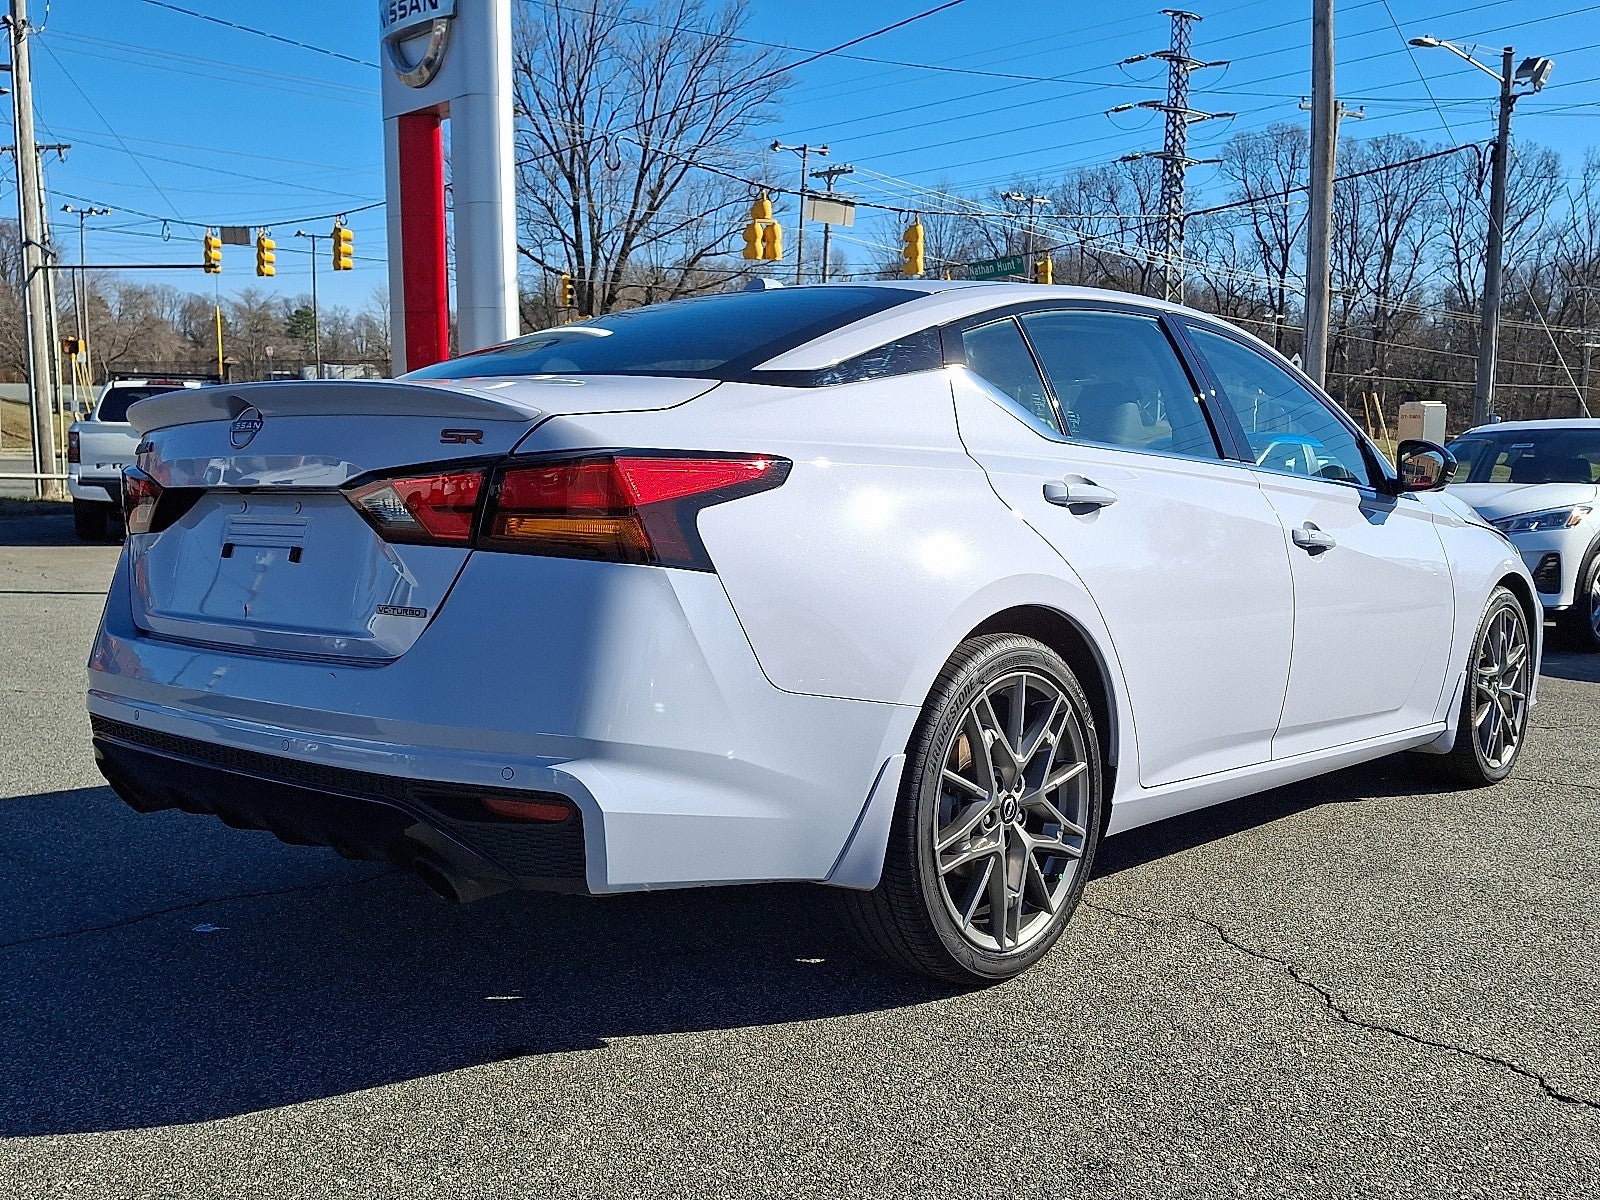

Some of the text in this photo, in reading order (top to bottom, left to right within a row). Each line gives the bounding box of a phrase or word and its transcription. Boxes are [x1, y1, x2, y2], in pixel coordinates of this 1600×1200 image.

[969, 264, 995, 276] Nathan
[997, 260, 1016, 272] Hunt
[440, 428, 484, 445] SR
[378, 606, 422, 617] VC-TURBO
